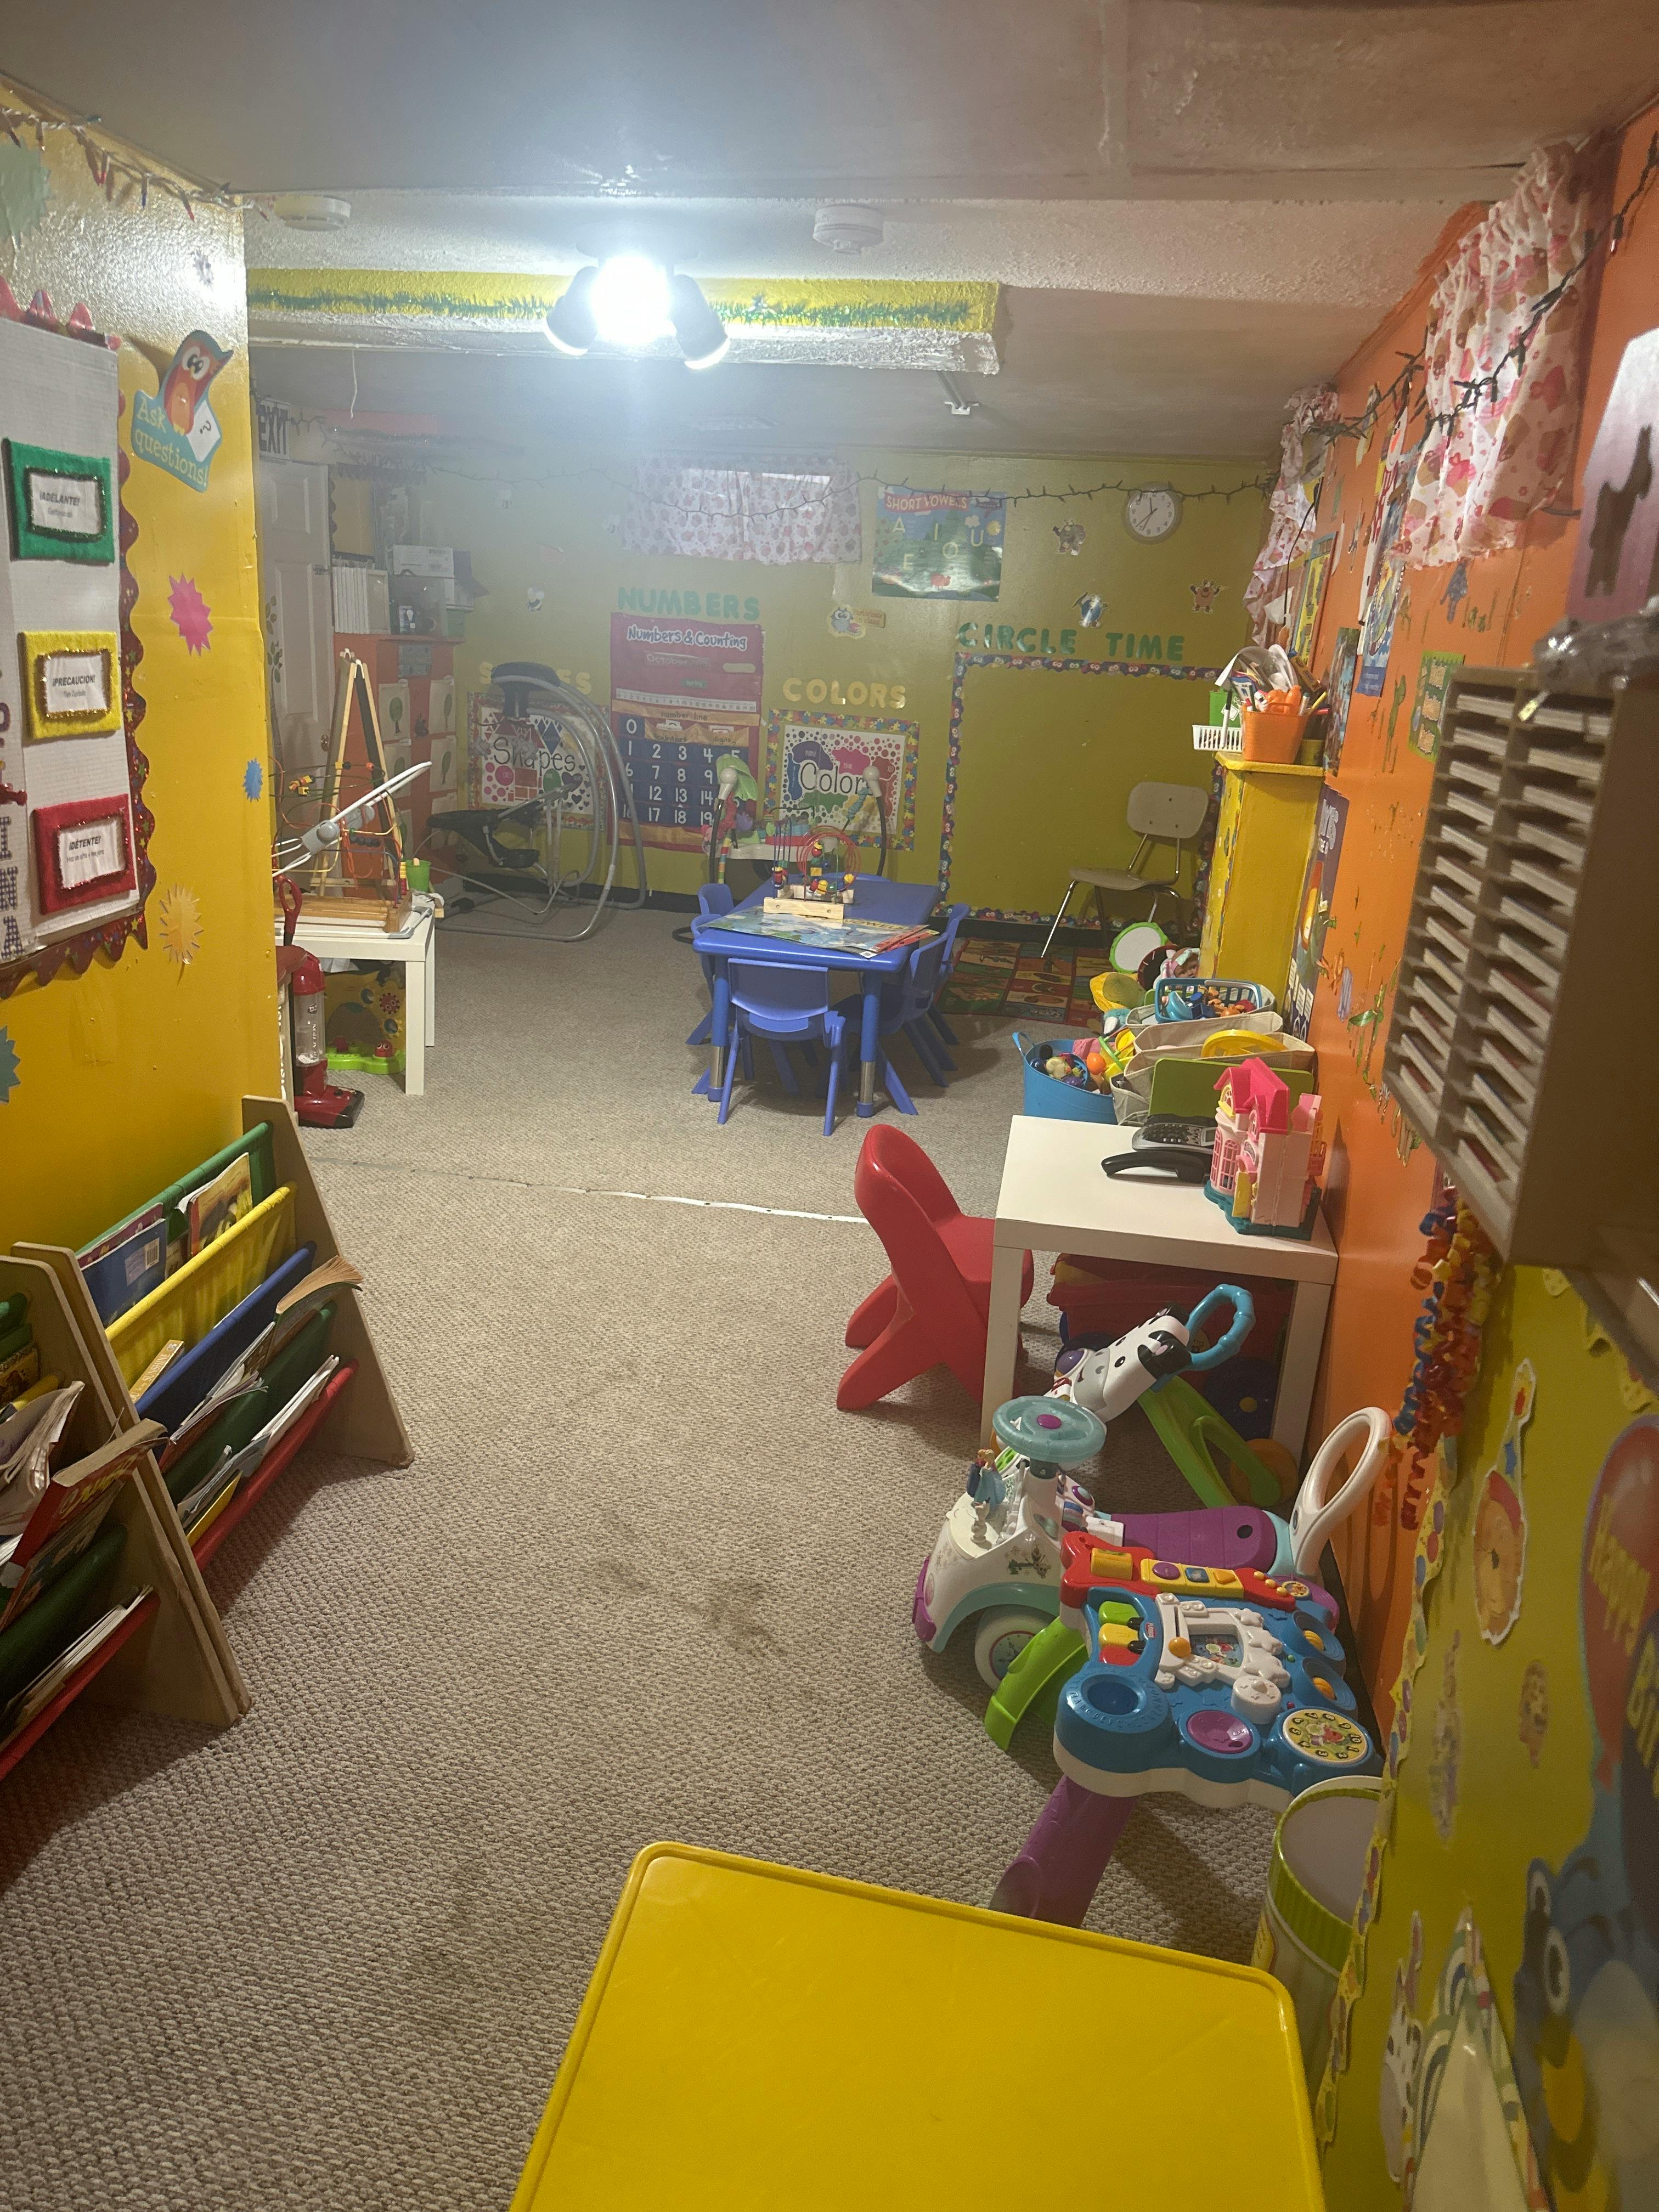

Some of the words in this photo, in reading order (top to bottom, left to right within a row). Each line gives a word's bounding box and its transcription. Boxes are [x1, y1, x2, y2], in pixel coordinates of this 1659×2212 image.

[137, 396, 166, 434] Ask
[135, 429, 207, 487] questions!
[886, 495, 922, 511] SHORT
[892, 516, 905, 532] A
[934, 523, 939, 540] I
[970, 529, 984, 547] U
[942, 541, 958, 559] O
[902, 554, 915, 571] E
[617, 586, 760, 622] NUMBERS
[628, 624, 682, 644] Numbers
[683, 629, 694, 645] &
[694, 631, 748, 652] Counting
[958, 622, 1077, 654] CIRCLE
[1105, 632, 1185, 661] TIME
[647, 653, 687, 666] October
[53, 674, 95, 687] ¡PRECAUCION!
[479, 661, 592, 695] SES
[783, 677, 906, 709] COLORS
[661, 711, 690, 719] number
[693, 713, 708, 721] line
[626, 719, 637, 734] 0
[628, 741, 632, 755] 1
[652, 743, 661, 759] 2
[678, 745, 687, 760] 3
[703, 748, 713, 763] 4
[625, 763, 634, 777] 6
[652, 765, 659, 780] 7
[678, 768, 686, 782] 8
[704, 769, 713, 785] 9
[800, 762, 865, 795] Color
[649, 785, 662, 801] 12
[675, 788, 687, 803] 13
[701, 790, 713, 805] 14
[648, 807, 661, 822] 17
[674, 809, 686, 824] 18
[701, 811, 713, 826] 19
[143, 1353, 171, 1382] SUNSHINE
